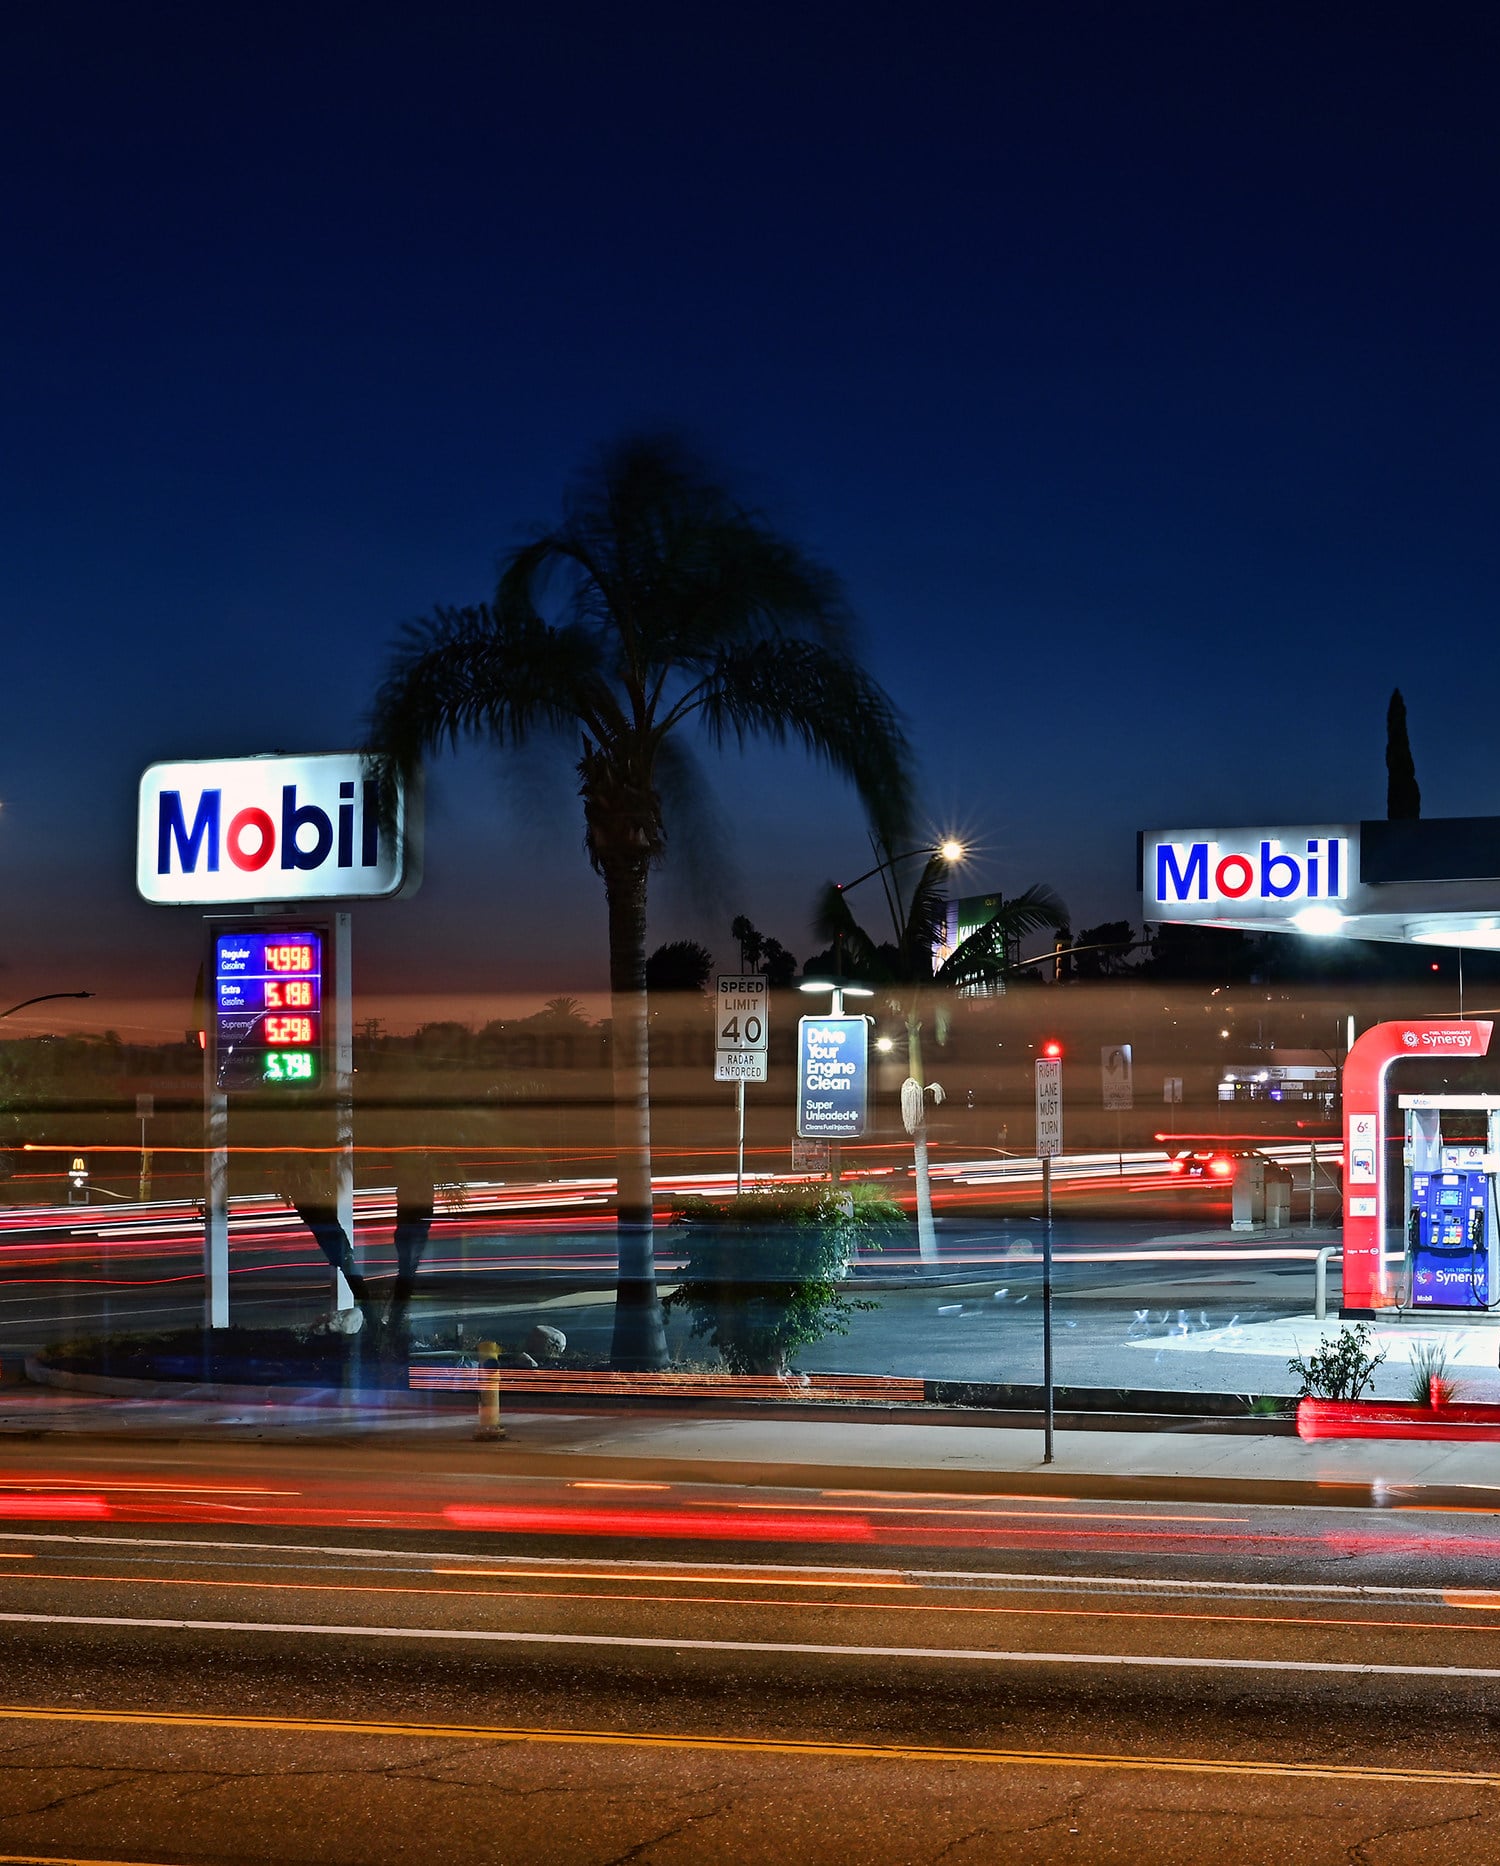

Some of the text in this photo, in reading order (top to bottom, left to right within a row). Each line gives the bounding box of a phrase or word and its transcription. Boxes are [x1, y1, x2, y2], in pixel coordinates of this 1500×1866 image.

[158, 779, 379, 875] Mobil
[1156, 838, 1340, 901] Mobil
[221, 948, 250, 960] Regular
[222, 961, 245, 970] Gasoline
[221, 985, 240, 994] Extra
[720, 981, 764, 993] SPEED
[222, 997, 244, 1006] Gasoline
[725, 999, 758, 1010] LIMIT
[721, 1016, 761, 1043] 40
[807, 1027, 846, 1044] Drive
[1421, 1034, 1472, 1047] Synergy
[807, 1044, 839, 1060] Your
[727, 1055, 754, 1065] RADAR
[720, 1066, 761, 1077] ENFORCED
[807, 1060, 856, 1077] Engine
[1039, 1064, 1057, 1078] RIGHT
[806, 1075, 851, 1091] Clean
[1040, 1083, 1058, 1097] LANE
[806, 1099, 833, 1114] Super
[1040, 1101, 1058, 1115] MUST
[1041, 1121, 1058, 1135] TURN
[1039, 1139, 1059, 1154] RIGHT
[1436, 1271, 1485, 1286] Synergy
